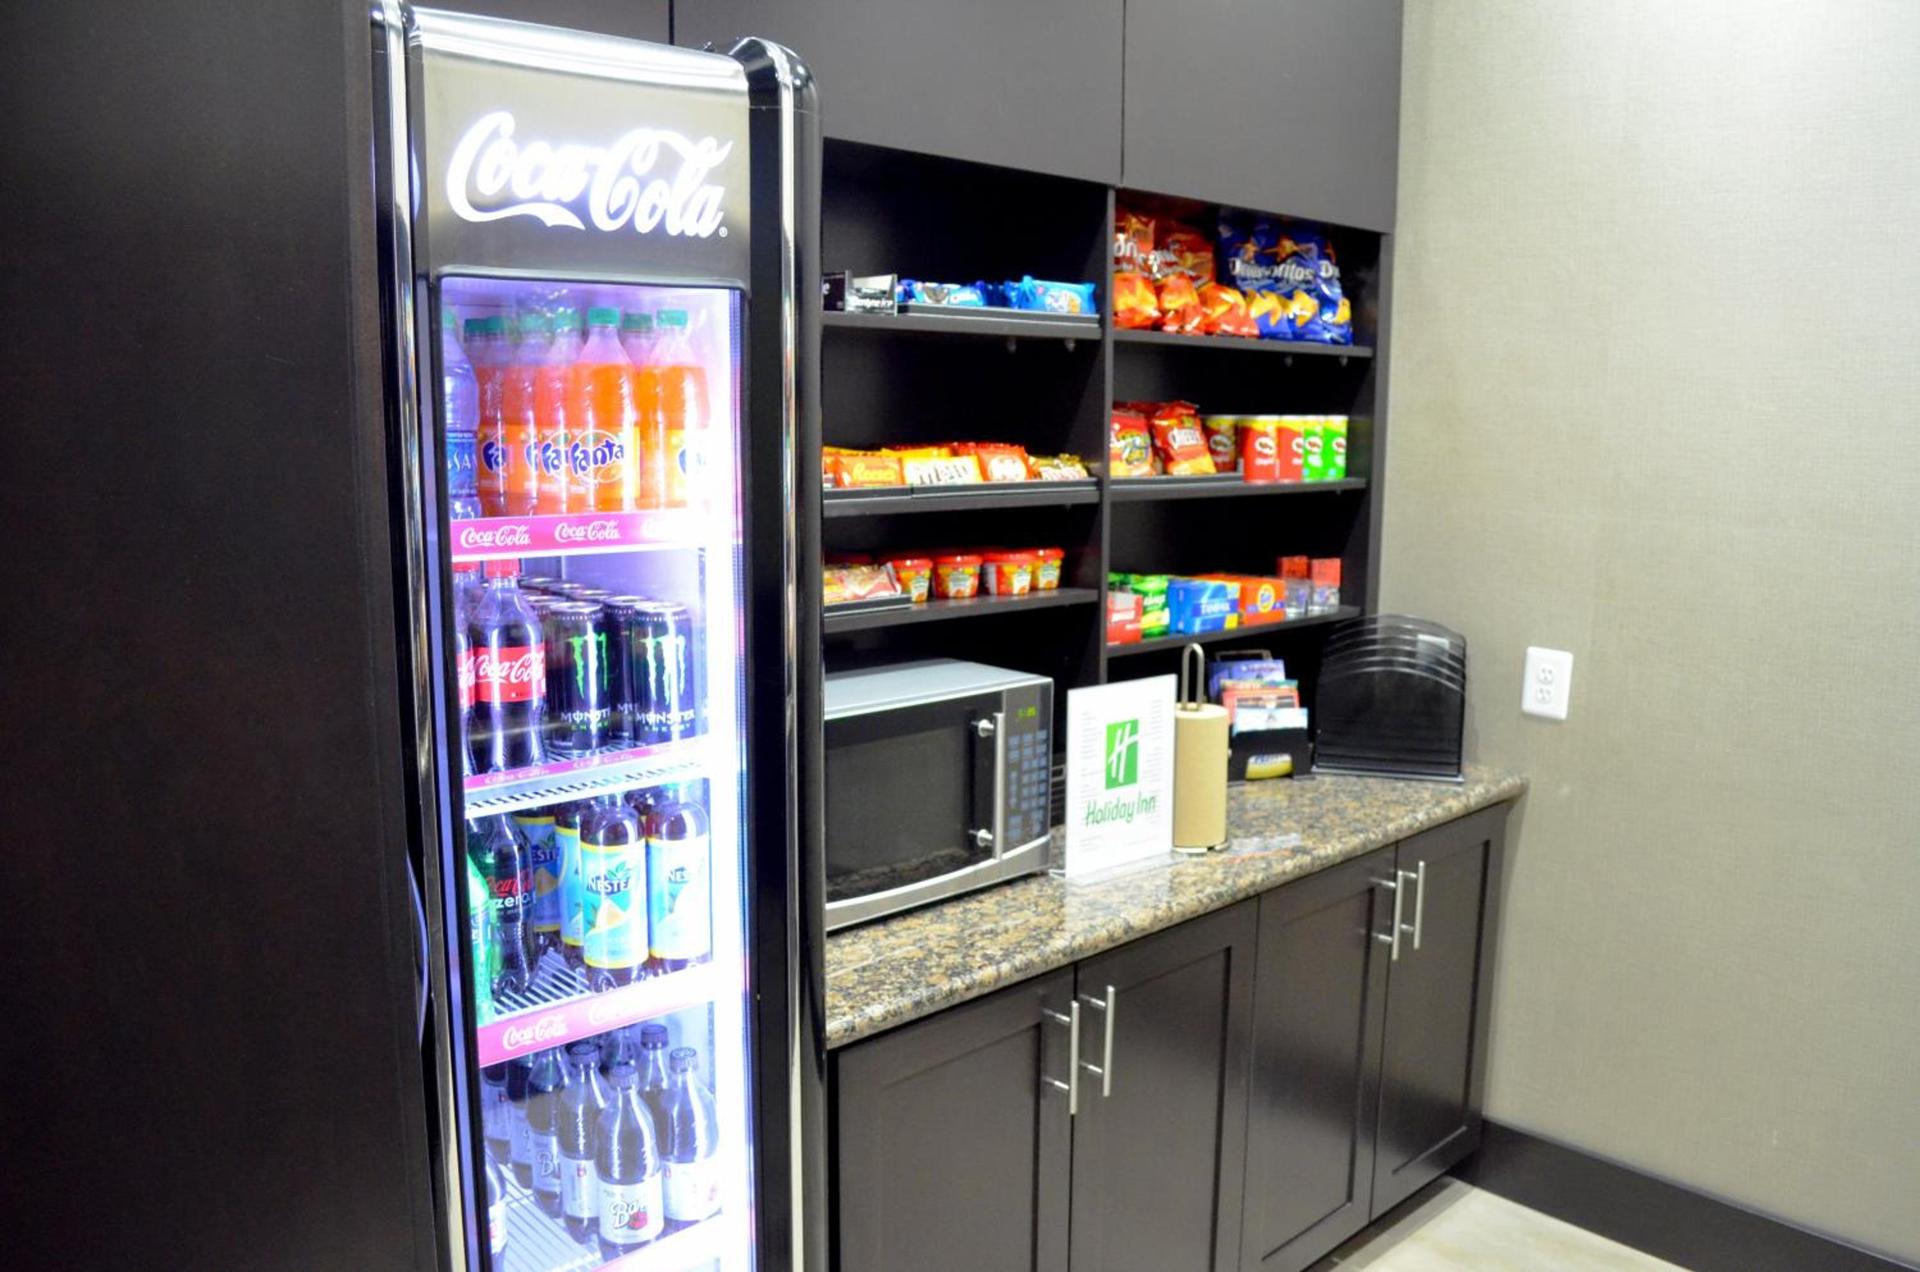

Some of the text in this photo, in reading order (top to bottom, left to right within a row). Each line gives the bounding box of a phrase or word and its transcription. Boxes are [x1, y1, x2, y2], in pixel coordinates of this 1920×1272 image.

[446, 110, 733, 238] Coca-Cola
[569, 440, 624, 475] Fanta
[461, 525, 530, 548] Coca-Cola
[554, 520, 621, 543] Coca-Cola
[1086, 790, 1157, 826] Holiday Inn
